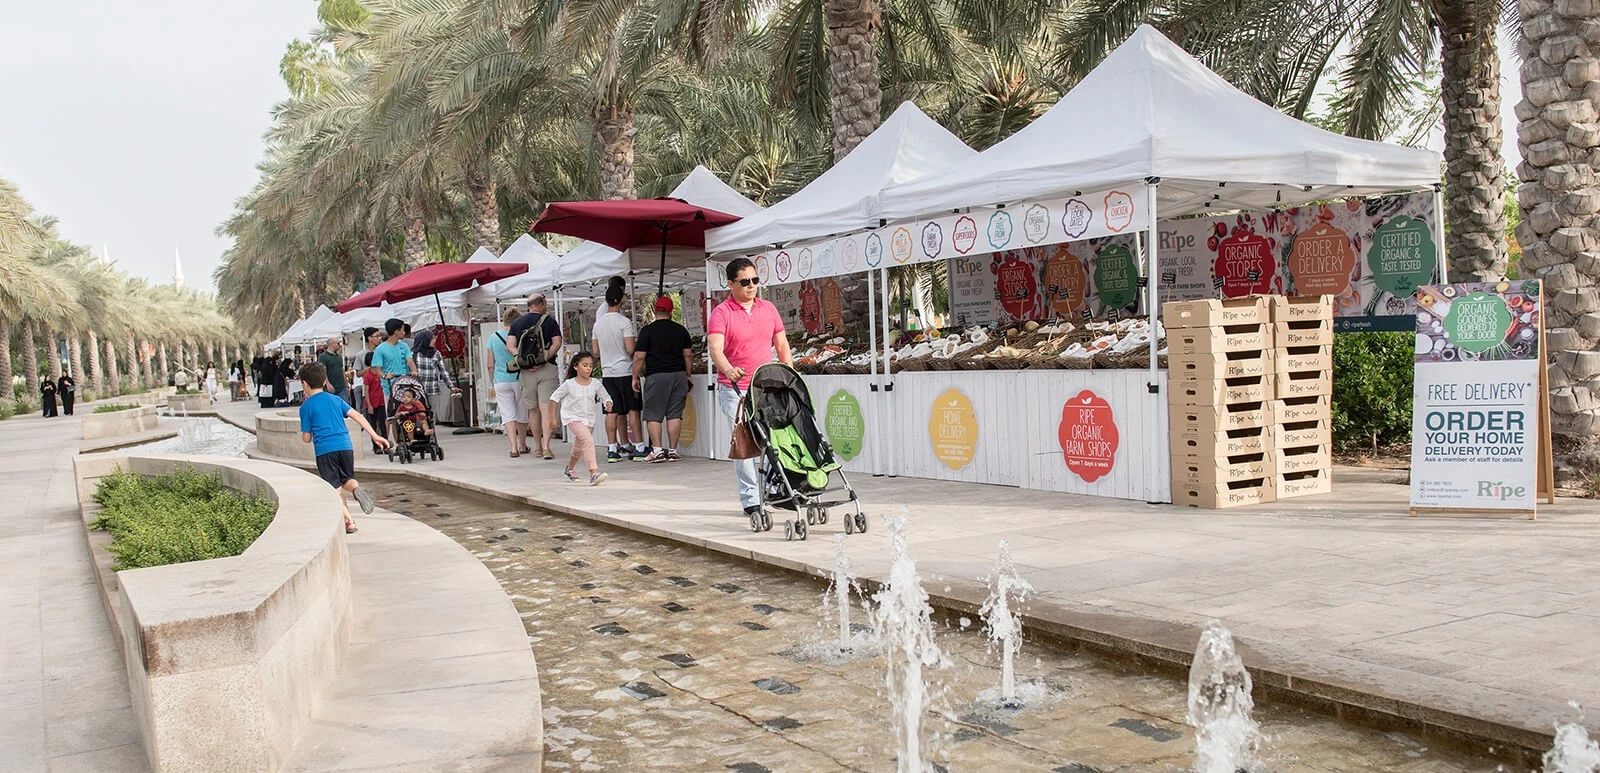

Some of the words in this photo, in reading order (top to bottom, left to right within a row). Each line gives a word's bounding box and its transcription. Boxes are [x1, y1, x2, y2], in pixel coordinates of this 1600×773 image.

[1072, 209, 1084, 219] LOCAL
[955, 230, 974, 240] SUPERFOODS
[1381, 232, 1420, 248] CERTIFIED
[1160, 230, 1196, 252] Ripe
[1225, 244, 1262, 260] ORGANIC
[1298, 240, 1332, 258] ORDER
[1337, 240, 1344, 254] A
[1381, 248, 1412, 261] ORGANIC
[1414, 248, 1420, 258] &
[1102, 257, 1126, 270] CERTIFIED
[1182, 256, 1196, 266] LOCAL
[1300, 256, 1344, 274] DELIVERY
[1381, 262, 1398, 272] TASTE
[1400, 260, 1420, 271] TESTED
[956, 258, 982, 276] Ripe
[1049, 262, 1072, 279] ORDER
[1075, 262, 1080, 274] A
[1002, 269, 1027, 282] ORGANIC
[1102, 270, 1121, 281] ORGANIC
[776, 288, 793, 302] Ripe
[1289, 308, 1304, 316] Ripe
[1457, 302, 1497, 315] ORGANIC
[1222, 310, 1238, 320] Ripe
[1457, 313, 1498, 325] GOODNESS
[1457, 323, 1486, 332] DELIVERED
[1489, 322, 1497, 331] TO
[1288, 334, 1302, 343] Ripe
[1457, 332, 1475, 340] YOUR
[1477, 330, 1497, 339] DOOR
[1226, 337, 1242, 346] Ripe
[1288, 360, 1302, 368] Ripe
[1229, 366, 1244, 375] Ripe
[1226, 389, 1242, 398] Ripe
[1289, 384, 1304, 392] Ripe
[1428, 384, 1457, 400] FREE
[832, 405, 852, 416] CERTIFIED
[1080, 408, 1095, 424] RIPE
[1284, 410, 1300, 419] Ripe
[830, 416, 847, 426] ORGANIC
[848, 416, 857, 426] AND
[944, 410, 961, 425] HOME
[1229, 416, 1244, 425] Ripe
[1425, 411, 1524, 431] ORDER
[830, 426, 842, 438] TASTE
[843, 427, 858, 438] TESTED
[939, 424, 967, 439] DELIVERY
[1072, 424, 1104, 440] ORGANIC
[1284, 434, 1300, 443] Ripe
[1425, 432, 1470, 444] YOUR
[1475, 432, 1524, 444] HOME
[1066, 440, 1085, 456] FARM
[1088, 441, 1112, 458] SHOPS
[1228, 443, 1242, 452] Ripe
[1425, 446, 1482, 456] DELIVERY
[1484, 446, 1524, 456] TODAY
[1284, 459, 1300, 468] Ripe
[1230, 468, 1245, 477] Ripe
[1284, 484, 1300, 493] Ripe
[1476, 480, 1526, 500] Ripe
[1229, 493, 1244, 502] Ripe
